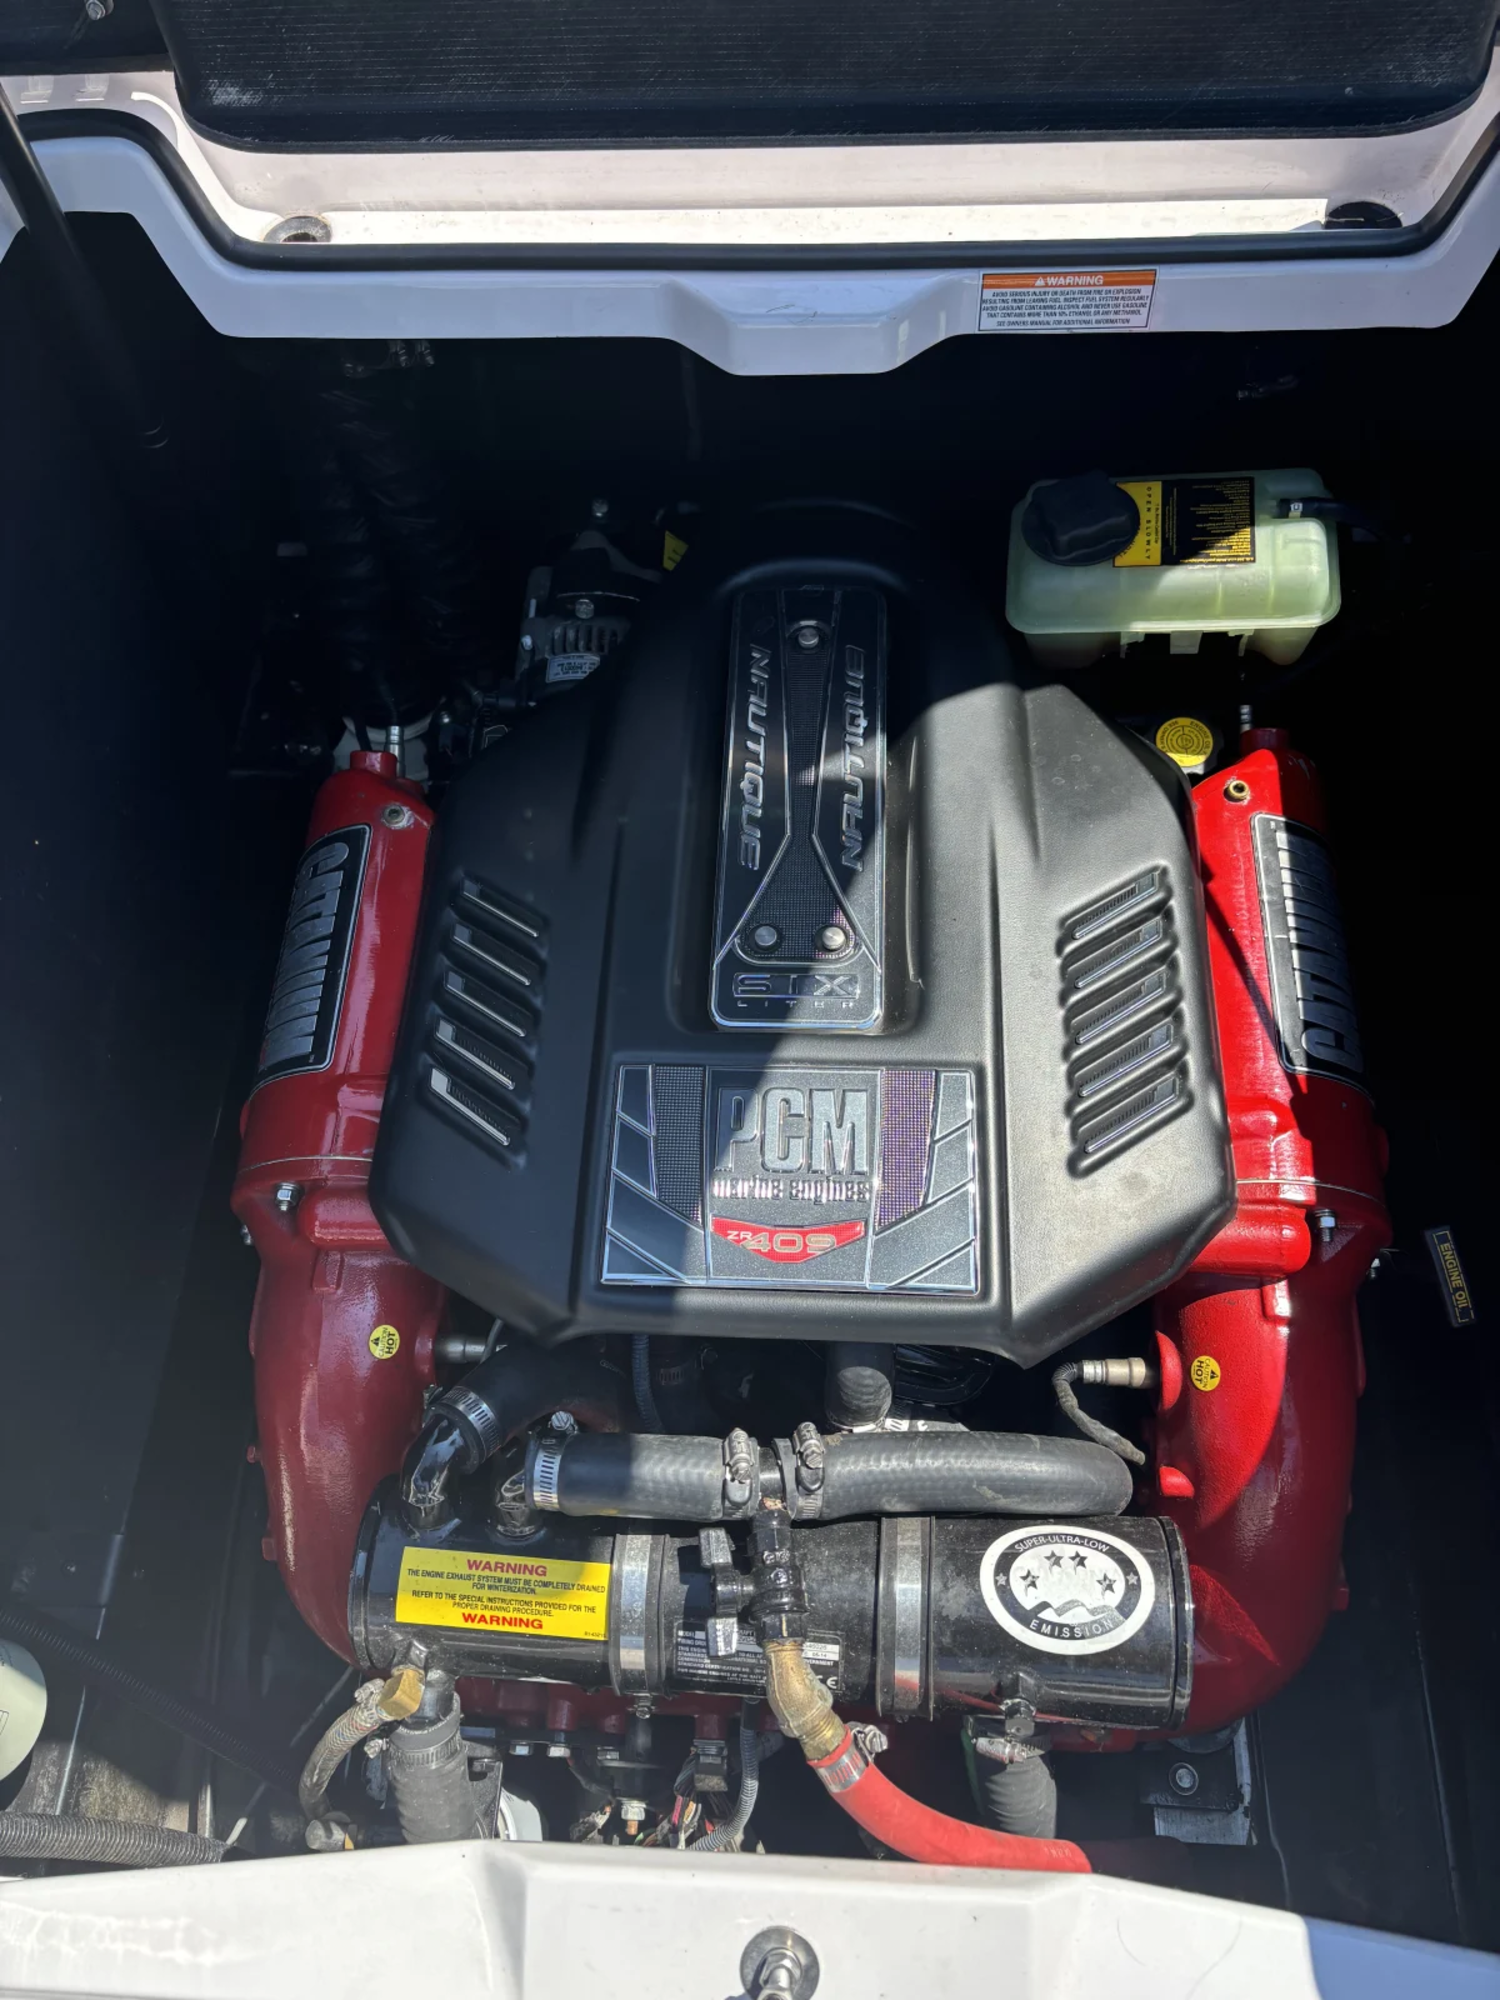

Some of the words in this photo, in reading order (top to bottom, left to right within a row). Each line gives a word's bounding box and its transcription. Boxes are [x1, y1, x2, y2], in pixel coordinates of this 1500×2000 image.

[1047, 275, 1104, 286] WARNING
[740, 644, 771, 871] NAUTIQUE
[842, 645, 868, 872] NAUTIQUE
[714, 1086, 869, 1175] PCM
[789, 1176, 870, 1205] engines
[1440, 1243, 1463, 1288] ENGINE
[385, 1331, 396, 1354] HOT
[1195, 1360, 1205, 1384] HOT
[1014, 1534, 1110, 1552] SUPER-ULTRA-LOW
[466, 1559, 547, 1577] WARNING
[408, 1568, 420, 1577] THE
[421, 1569, 445, 1579] ENGINE
[446, 1572, 475, 1582] EXHAUST
[477, 1575, 502, 1585] SYSTEM
[504, 1577, 522, 1585] MUST
[524, 1579, 532, 1587] BE
[534, 1580, 576, 1590] COMPLETELY
[576, 1583, 605, 1593] DRAINED
[472, 1582, 486, 1590] FOR
[412, 1590, 433, 1599] REFER
[435, 1592, 443, 1600] TO
[445, 1593, 457, 1601] THE
[458, 1594, 485, 1603] SPECIAL
[487, 1597, 533, 1608] INSTRUCTIONS
[535, 1601, 567, 1611] PROVIDED
[569, 1604, 582, 1612] FOR
[584, 1605, 596, 1614] THE
[452, 1601, 479, 1610] PROPER
[480, 1603, 510, 1613] DRAINING
[462, 1612, 543, 1630] WARNING
[1029, 1619, 1113, 1638] EMISSION
